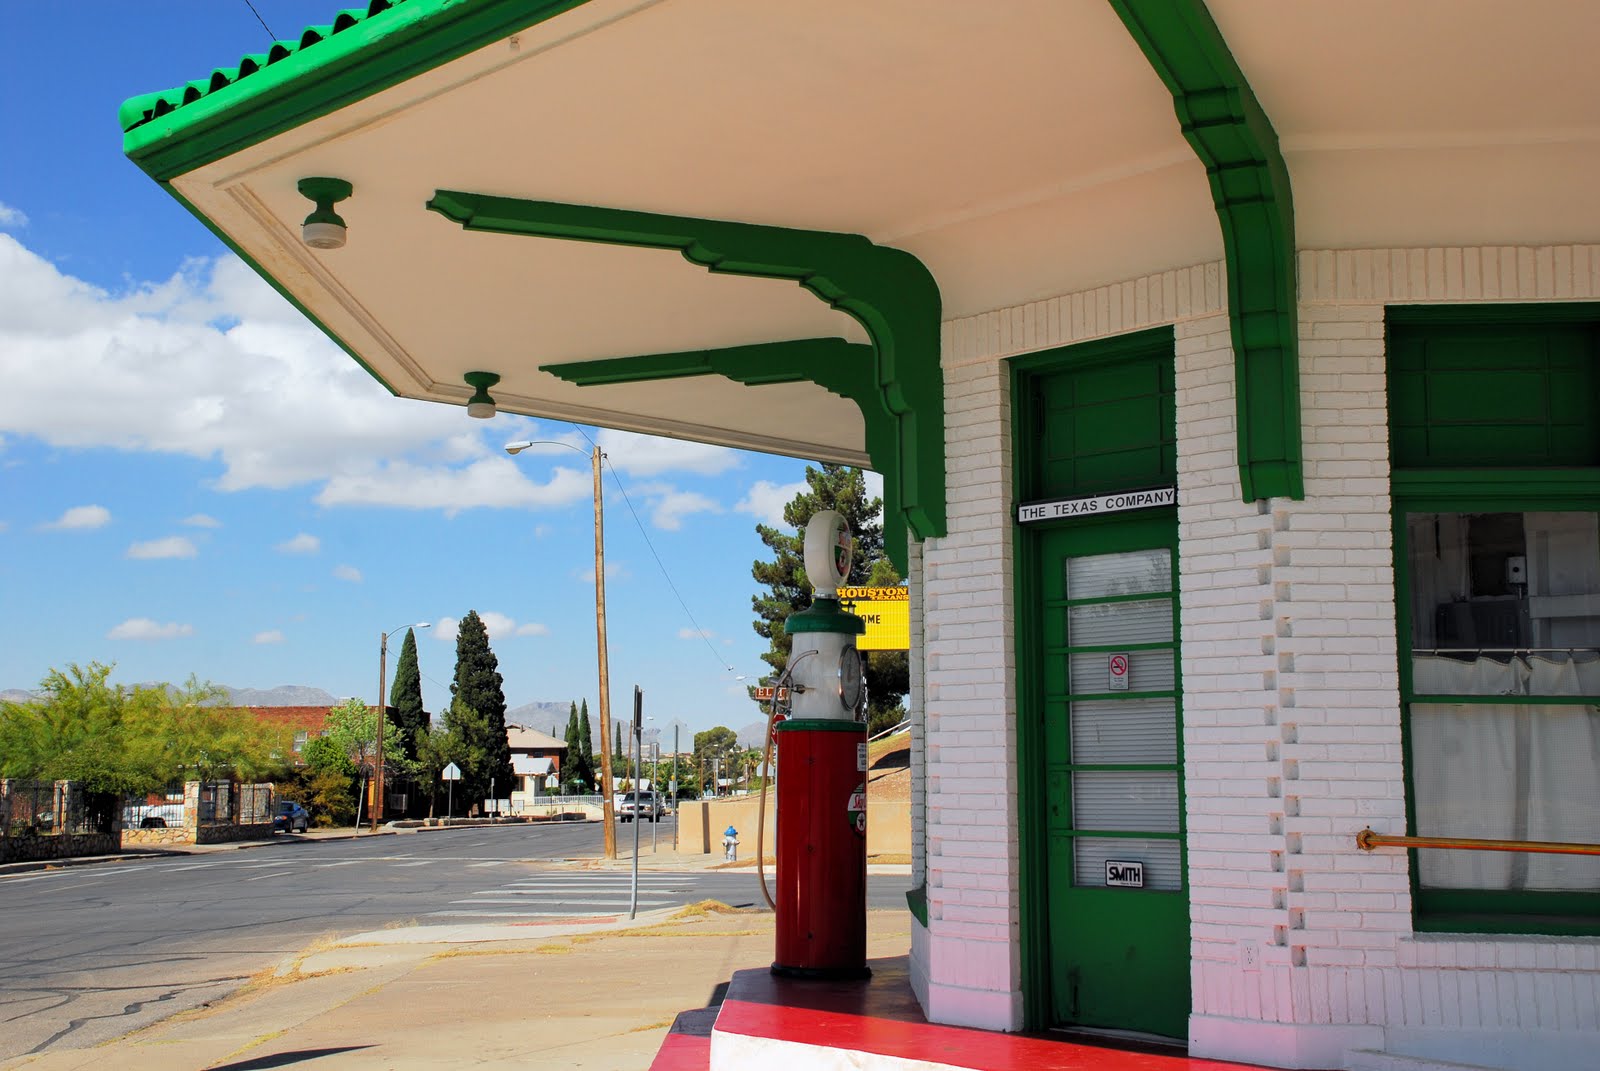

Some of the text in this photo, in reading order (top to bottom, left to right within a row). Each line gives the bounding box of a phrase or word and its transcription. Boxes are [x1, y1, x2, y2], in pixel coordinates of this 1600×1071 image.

[1022, 490, 1174, 519] THE TEXAS COMPANY
[836, 588, 908, 599] HOUSTON
[1108, 866, 1141, 882] SMITH
